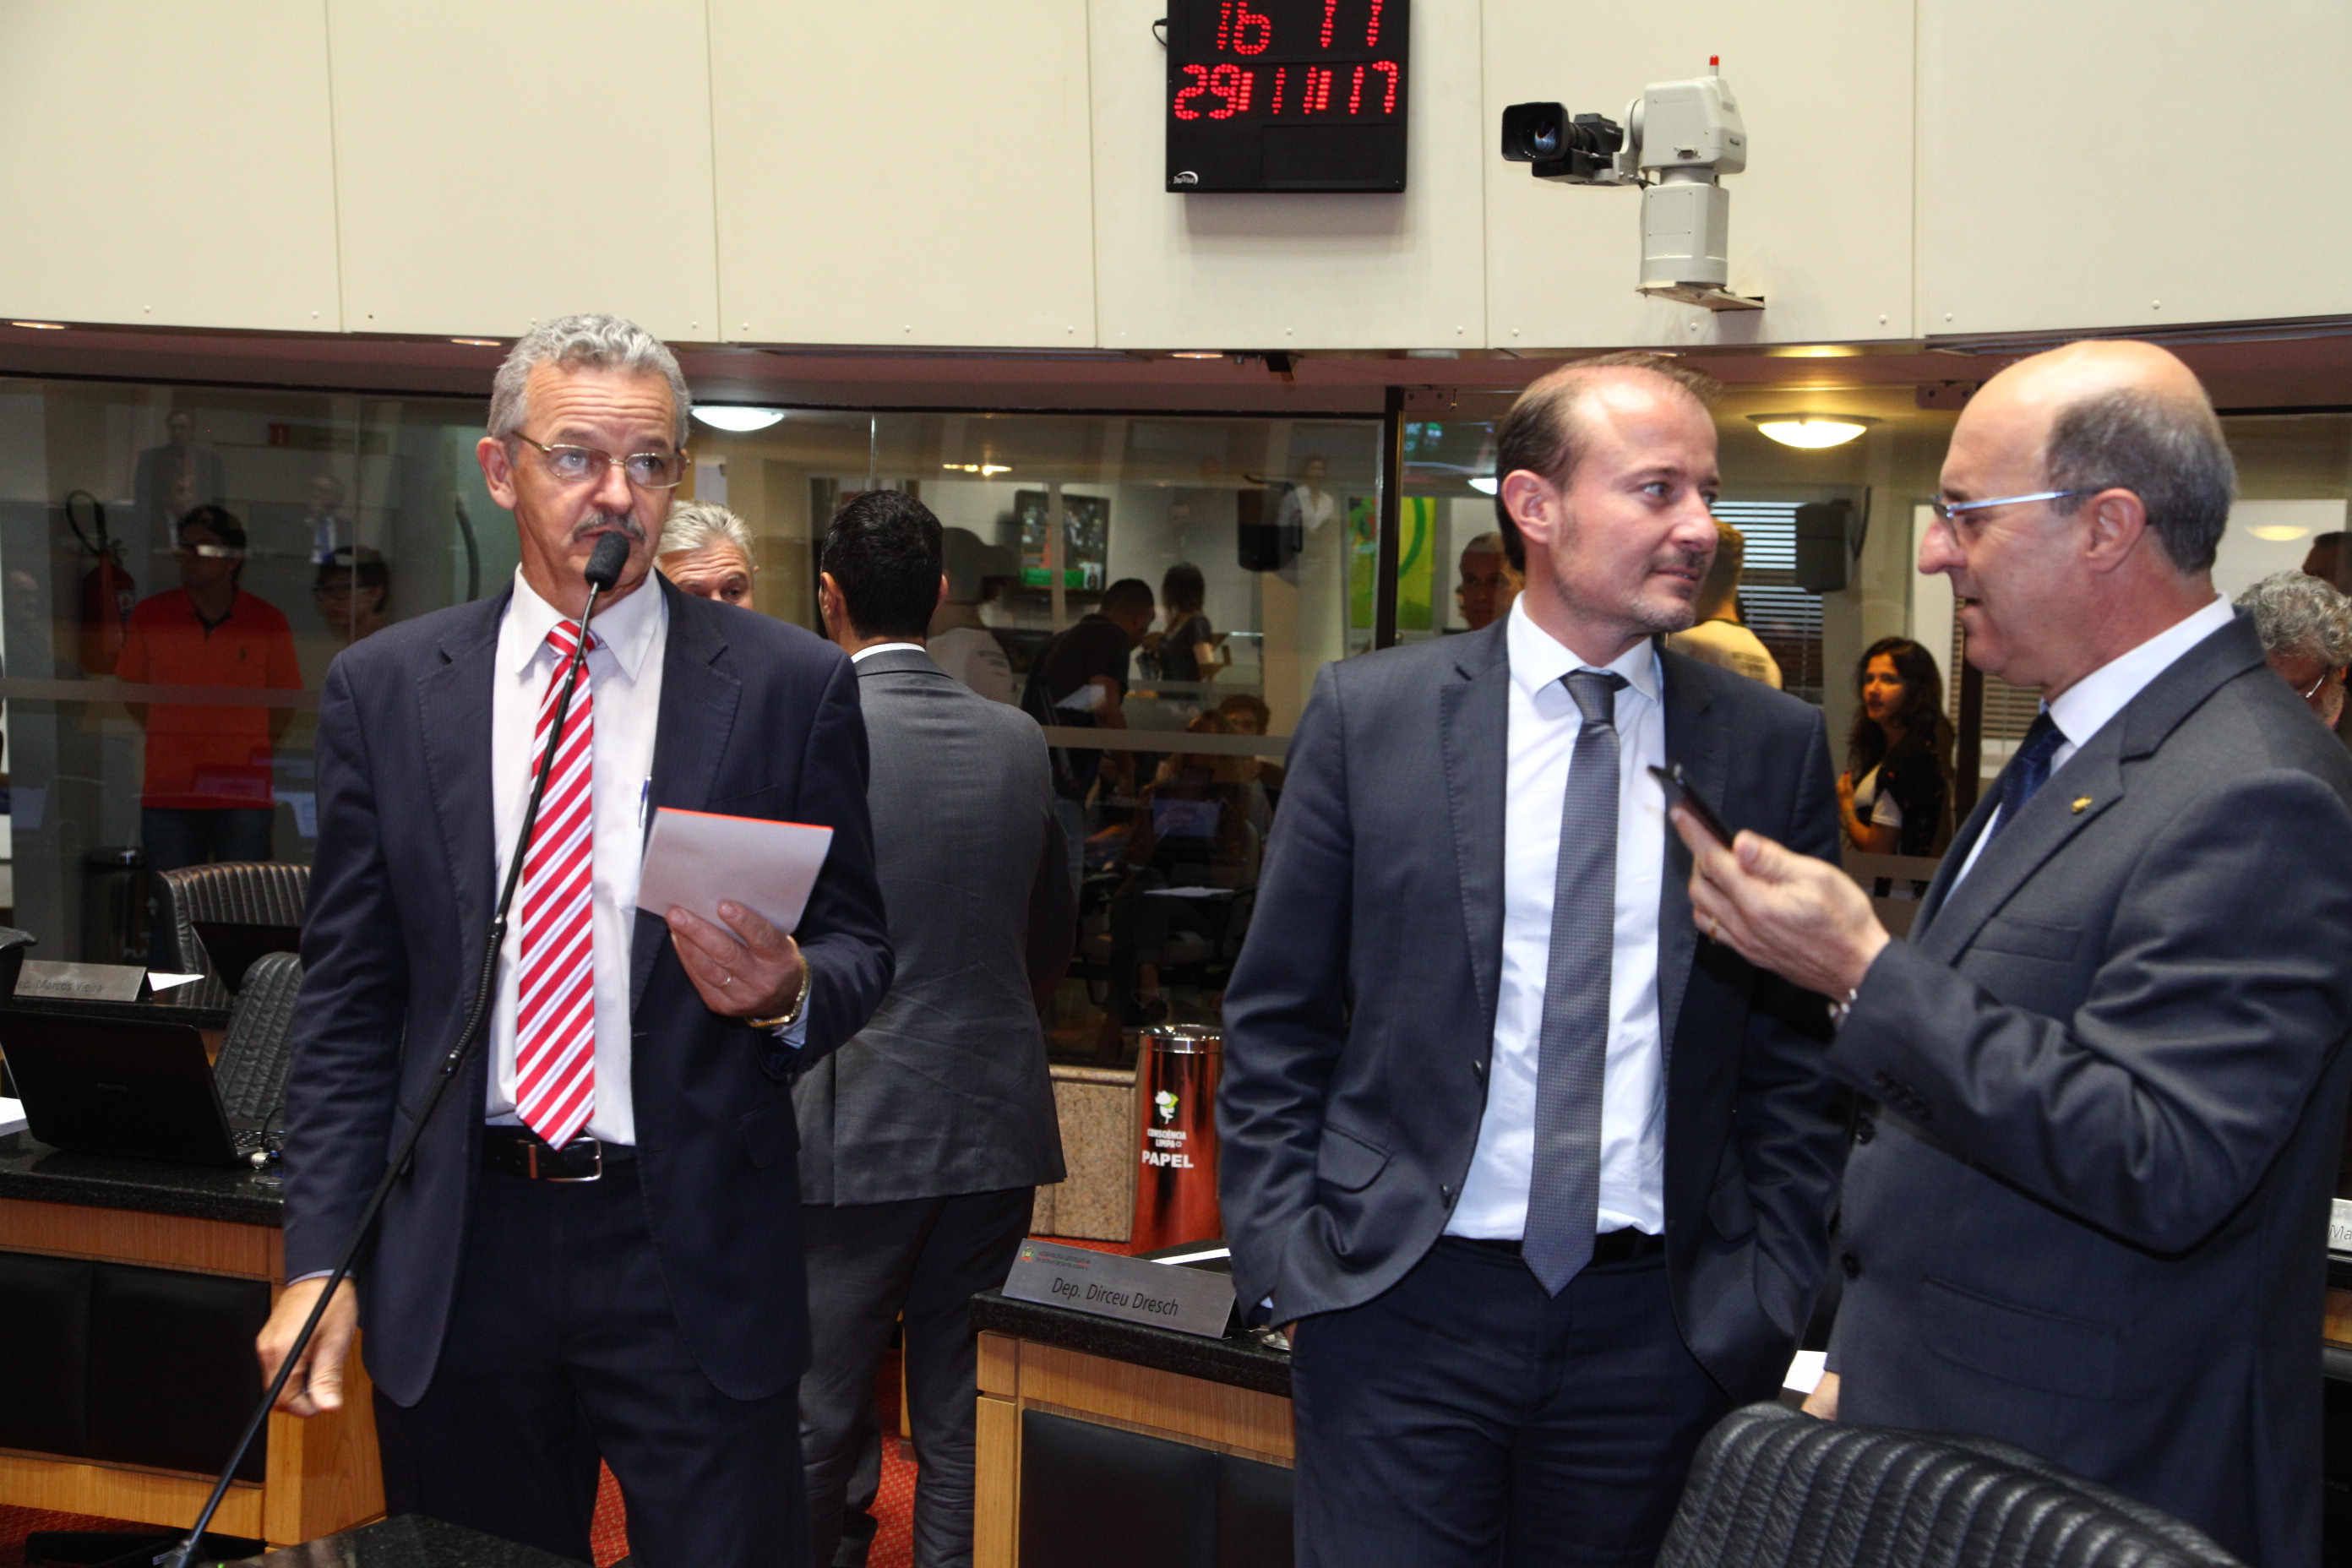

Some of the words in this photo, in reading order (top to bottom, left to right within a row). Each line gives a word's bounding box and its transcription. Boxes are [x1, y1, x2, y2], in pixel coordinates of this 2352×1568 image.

[17, 979, 31, 990] ep.
[35, 979, 72, 992] Marcos
[76, 981, 103, 993] Vieira
[1141, 1150, 1195, 1168] PAPEL
[1052, 1277, 1081, 1300] Dep.
[1086, 1283, 1130, 1307] Dirceu
[1132, 1292, 1179, 1316] Dresch
